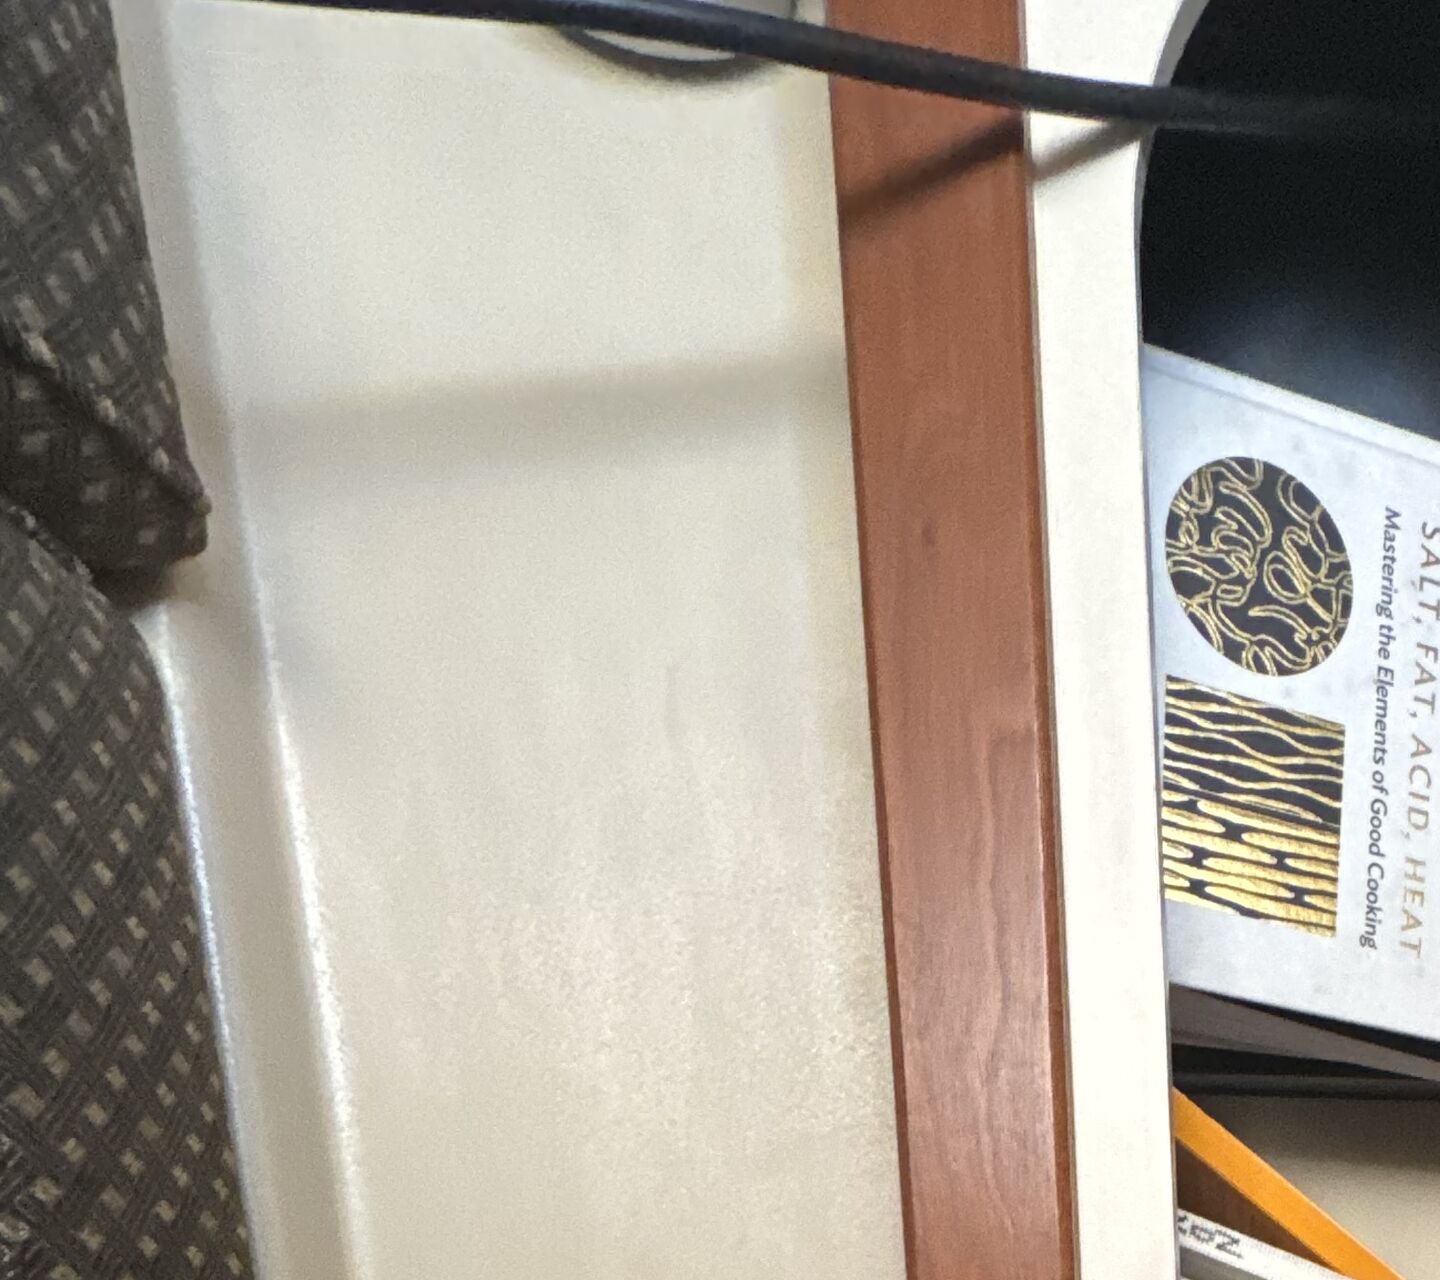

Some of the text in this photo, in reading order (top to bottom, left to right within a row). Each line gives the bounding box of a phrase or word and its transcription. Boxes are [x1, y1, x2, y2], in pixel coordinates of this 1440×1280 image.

[1360, 506, 1401, 949] Mastering the Elements of Good Cooking
[1409, 642, 1438, 718] FAT,
[1402, 734, 1433, 840] ACID,
[1400, 857, 1426, 959] HEAT
